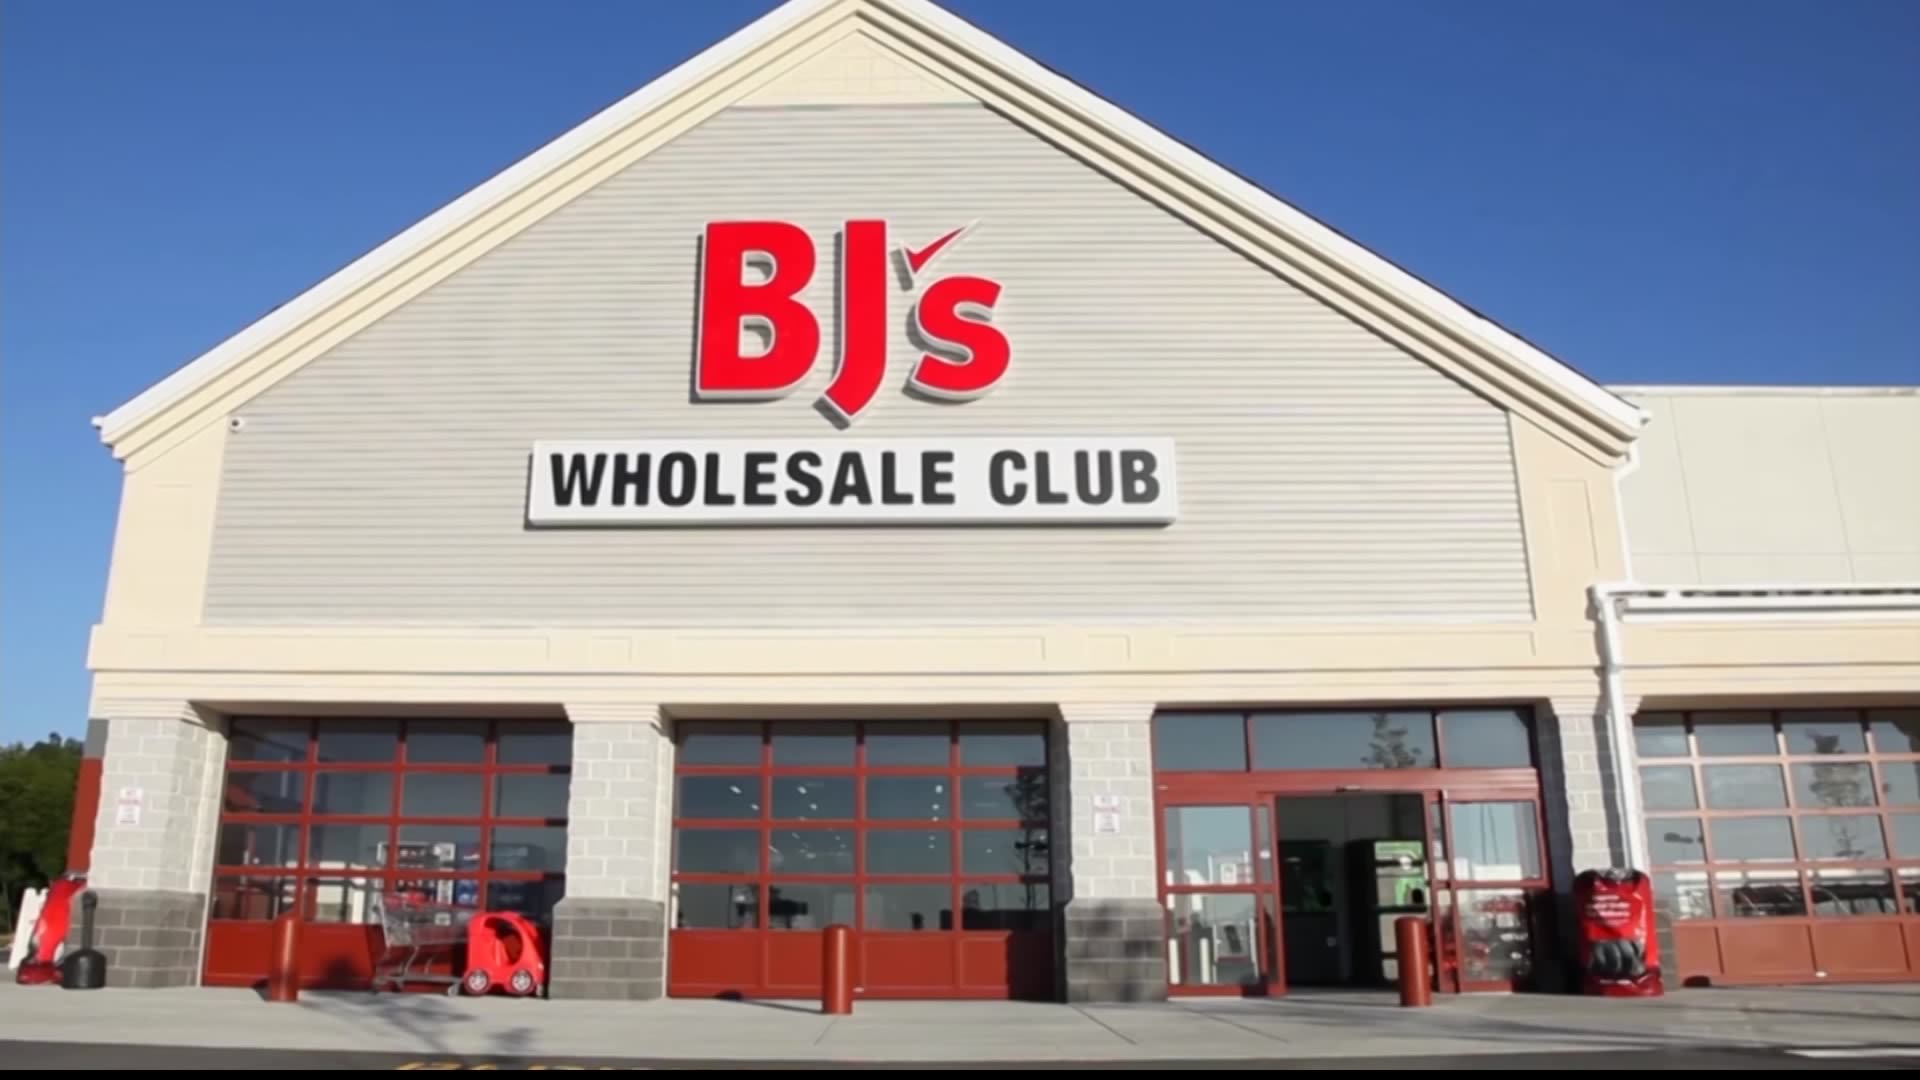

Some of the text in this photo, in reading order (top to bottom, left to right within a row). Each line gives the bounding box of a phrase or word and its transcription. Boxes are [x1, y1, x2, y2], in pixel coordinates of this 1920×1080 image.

[696, 218, 1013, 420] BJ's
[550, 448, 1161, 507] WHOLESALE CLUB
